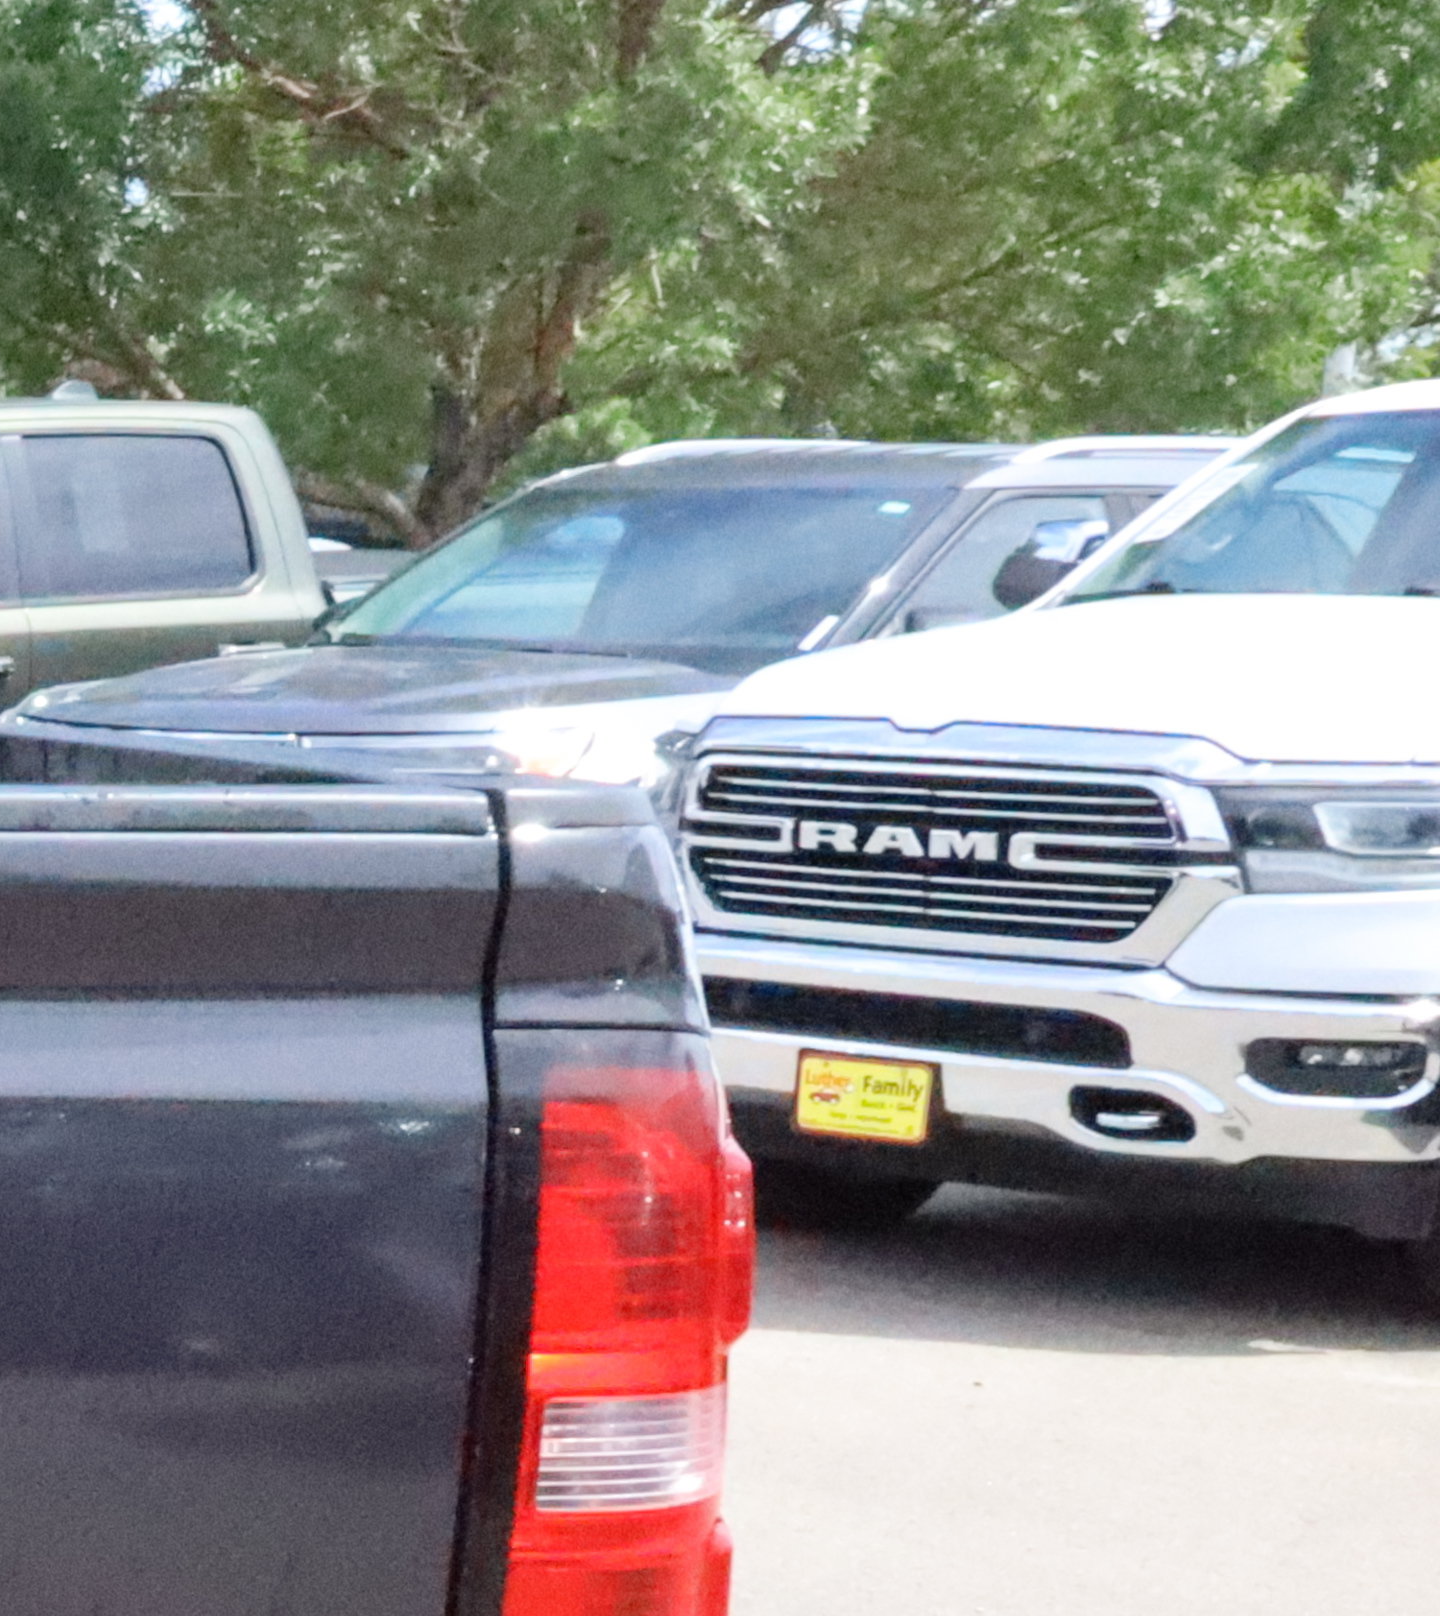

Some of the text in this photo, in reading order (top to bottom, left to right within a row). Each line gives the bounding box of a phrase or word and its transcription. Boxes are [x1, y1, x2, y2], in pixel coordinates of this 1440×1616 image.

[799, 820, 998, 861] RAM
[805, 1069, 852, 1088] Luther
[862, 1074, 924, 1103] Family
